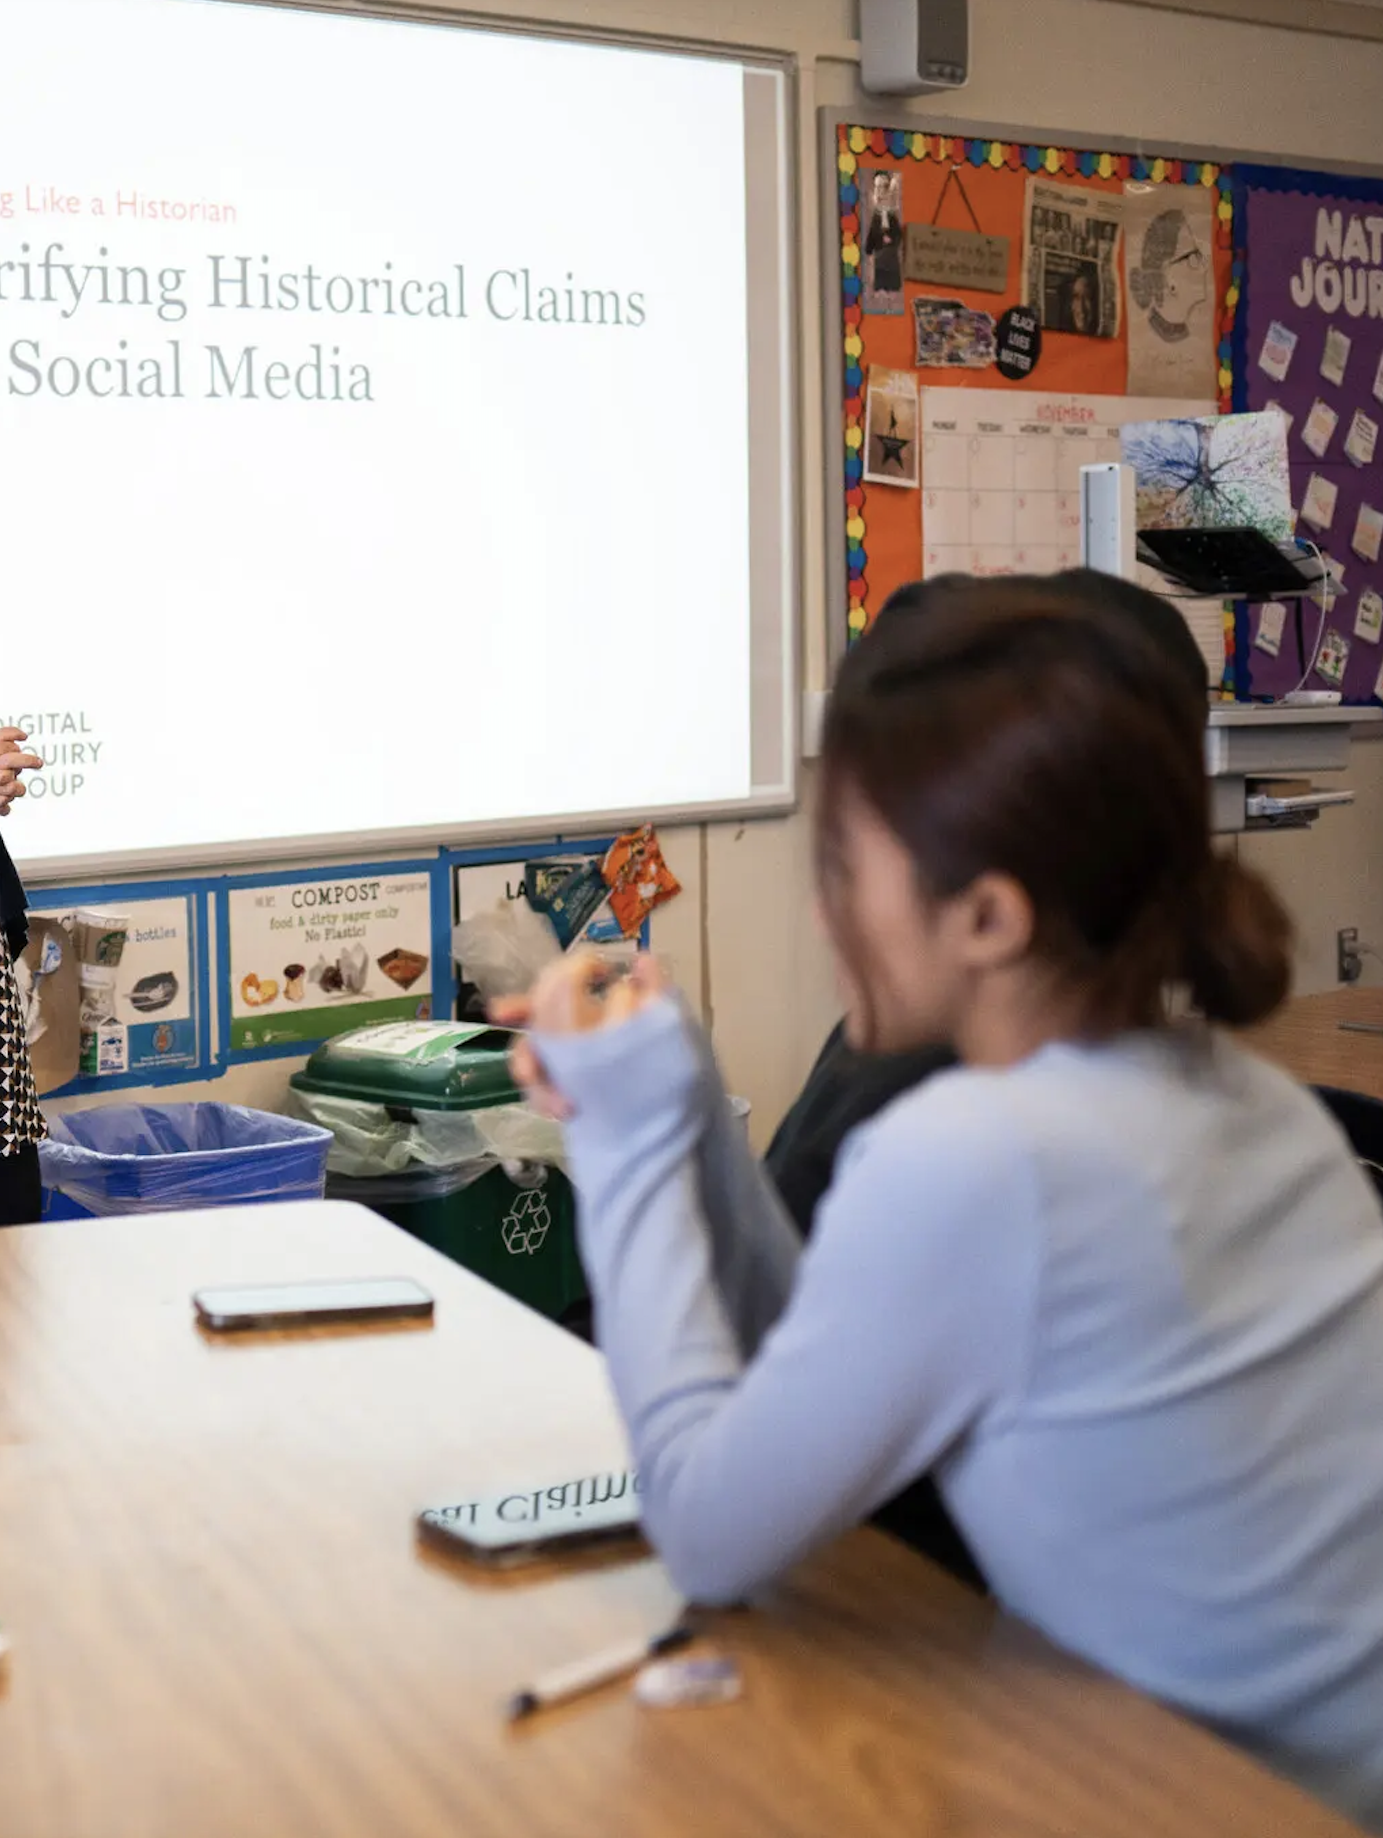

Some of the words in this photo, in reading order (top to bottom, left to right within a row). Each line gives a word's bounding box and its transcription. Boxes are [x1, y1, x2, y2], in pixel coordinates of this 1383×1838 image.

[25, 184, 81, 215] Like
[90, 197, 106, 217] a
[116, 190, 238, 224] Historian
[206, 253, 469, 319] Historical
[485, 267, 647, 328] Claims
[1010, 312, 1037, 332] BLACK
[7, 338, 186, 398] Social
[203, 342, 375, 402] Media
[1000, 348, 1032, 371] MATTER
[291, 882, 381, 908] COMPOST
[270, 916, 293, 931] food
[310, 911, 340, 927] dirty
[342, 908, 371, 925] paper
[374, 905, 400, 920] only
[135, 926, 177, 943] bottles
[305, 929, 321, 943] No
